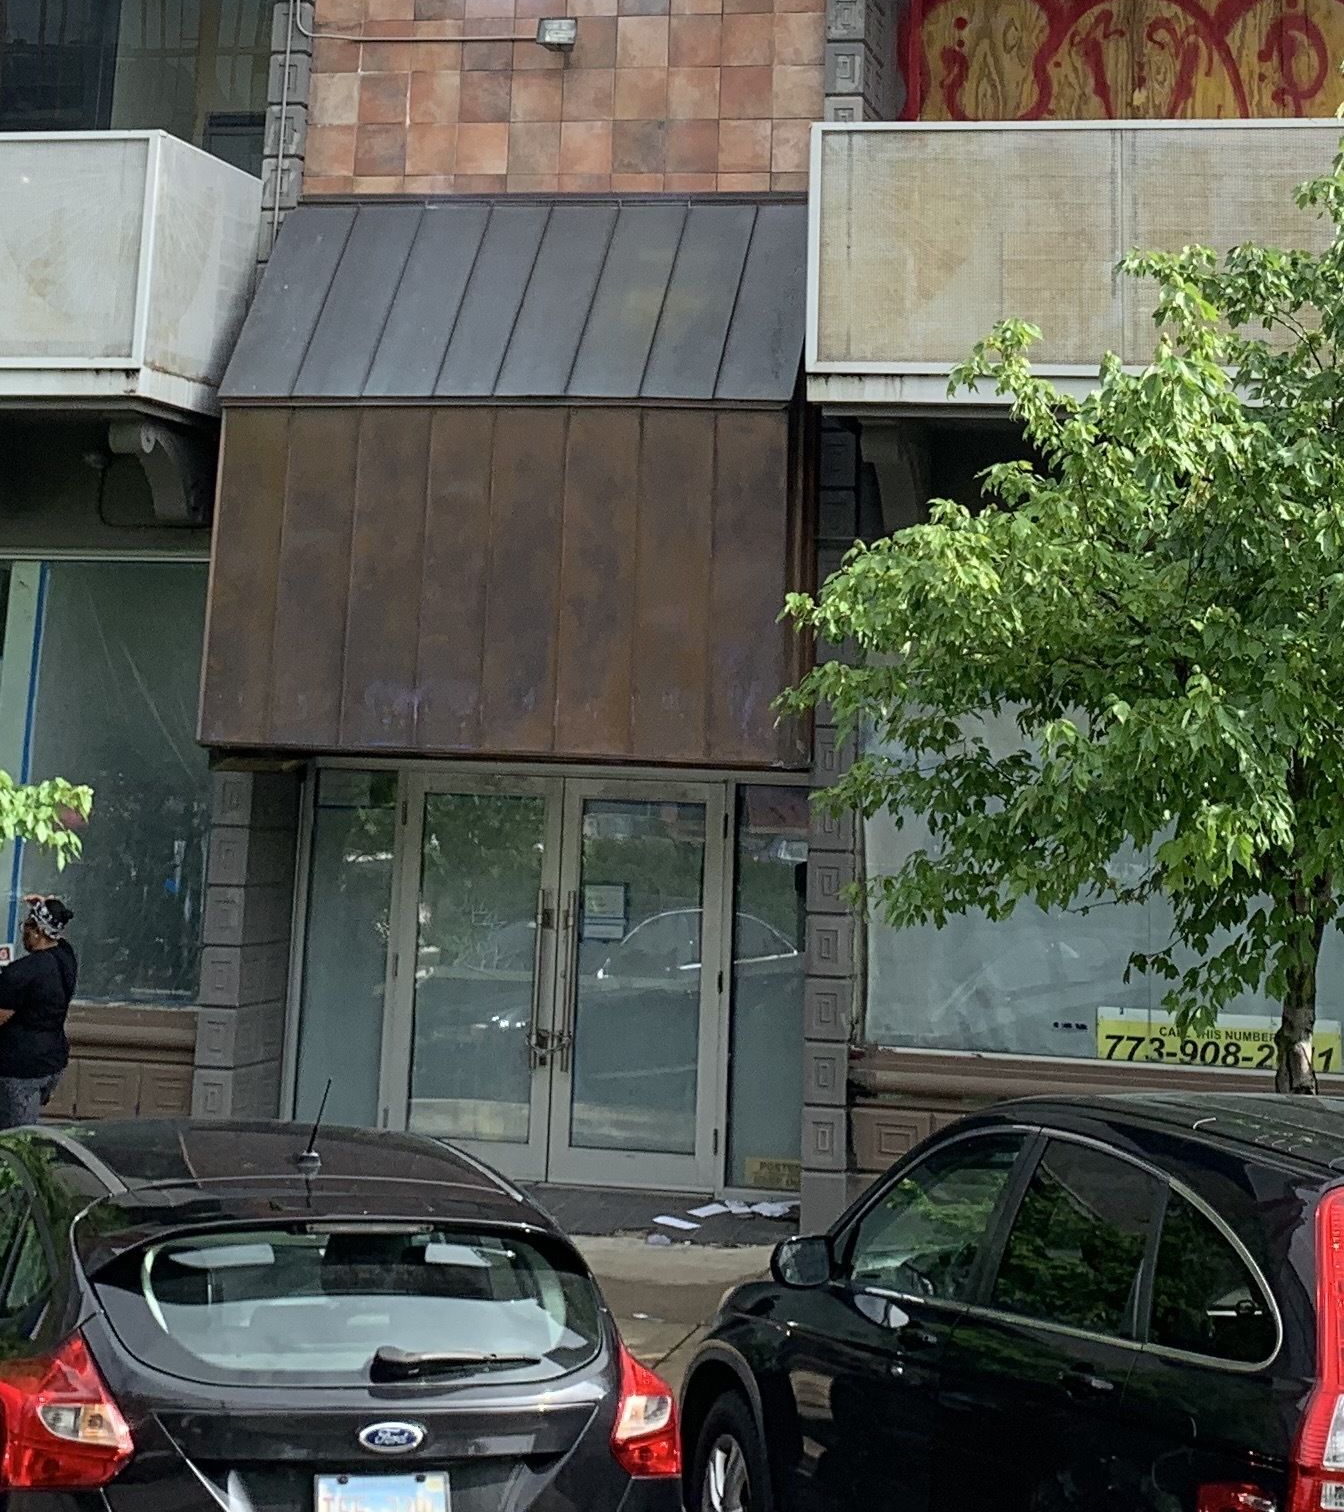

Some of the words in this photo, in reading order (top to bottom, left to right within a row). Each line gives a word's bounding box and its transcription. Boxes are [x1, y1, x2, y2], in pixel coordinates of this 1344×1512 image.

[1225, 1030, 1277, 1043] NUMBER
[1104, 1034, 1334, 1073] 773-908-21
[374, 1427, 410, 1446] Ford
